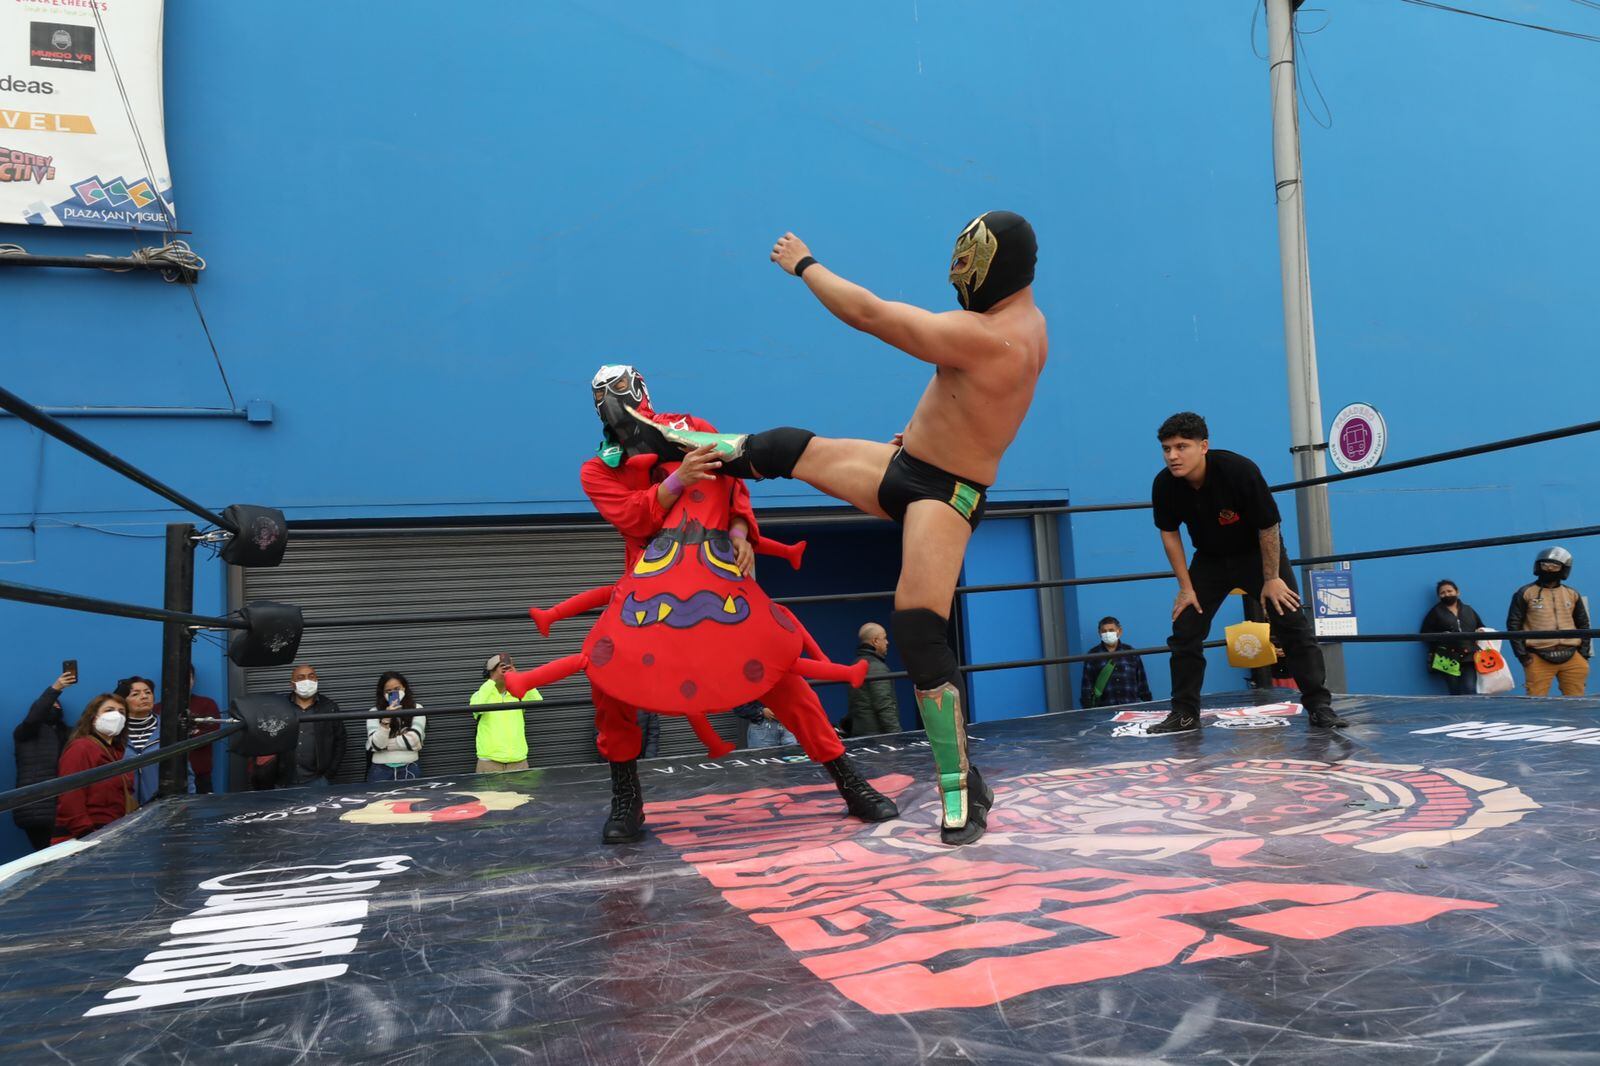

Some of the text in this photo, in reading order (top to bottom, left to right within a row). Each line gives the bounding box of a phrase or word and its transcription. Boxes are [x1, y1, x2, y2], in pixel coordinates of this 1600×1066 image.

[31, 49, 73, 59] MUNDO
[75, 52, 93, 62] VR
[63, 207, 169, 224] PLAZA SAN MIGUEL
[653, 756, 786, 775] MEDIA
